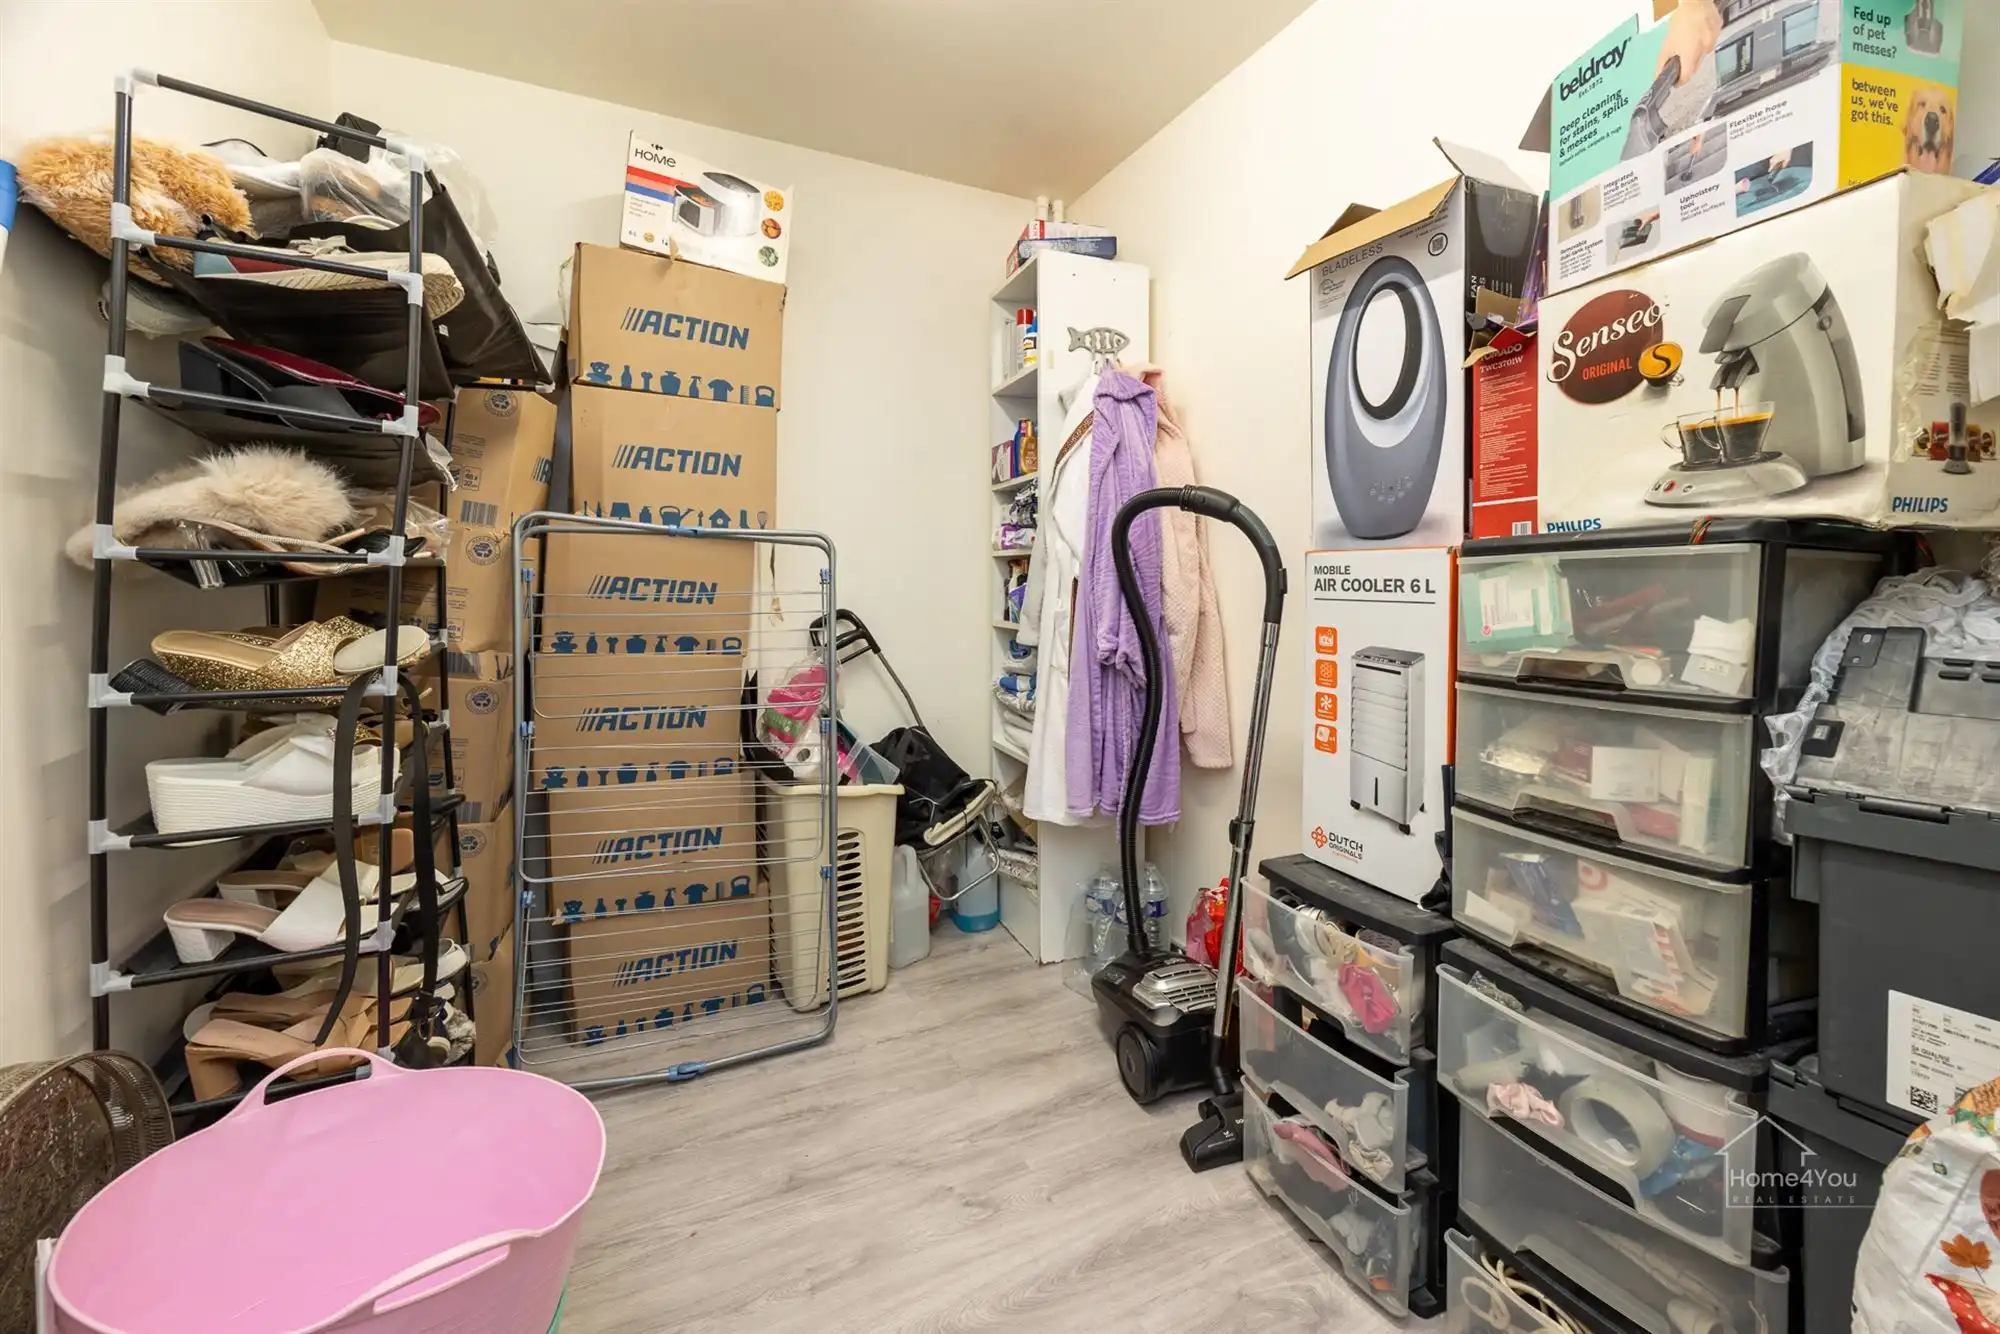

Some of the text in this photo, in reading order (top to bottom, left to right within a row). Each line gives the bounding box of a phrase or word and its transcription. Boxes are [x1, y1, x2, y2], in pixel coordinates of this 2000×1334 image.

[1853, 6, 1892, 28] Fed up
[1852, 24, 1886, 40] of pet
[1852, 41, 1897, 58] messes?
[1559, 38, 1628, 101] beldray
[1851, 78, 1897, 97] between
[1560, 89, 1623, 137] Deep cleaning
[1851, 95, 1899, 113] us, we've
[1560, 96, 1629, 147] for stains, spills
[1850, 110, 1894, 126] got this.
[1566, 128, 1598, 153] messes
[1322, 243, 1383, 277] BLADELESS
[639, 309, 750, 350] ACTION
[1546, 302, 1665, 384] Senseo
[1582, 356, 1632, 380] ORIGINAL
[631, 445, 743, 477] ACTION
[1892, 495, 1949, 513] PHILIPS
[1546, 517, 1602, 534] PHILIPS
[1313, 565, 1351, 576] MOBILE
[605, 576, 718, 605] ACTION
[1313, 578, 1436, 594] AIR COOLER 6 L
[596, 704, 709, 732] ACTION
[610, 825, 723, 864] ACTION
[1329, 832, 1363, 852] DUTCH
[630, 939, 738, 985] ACTION
